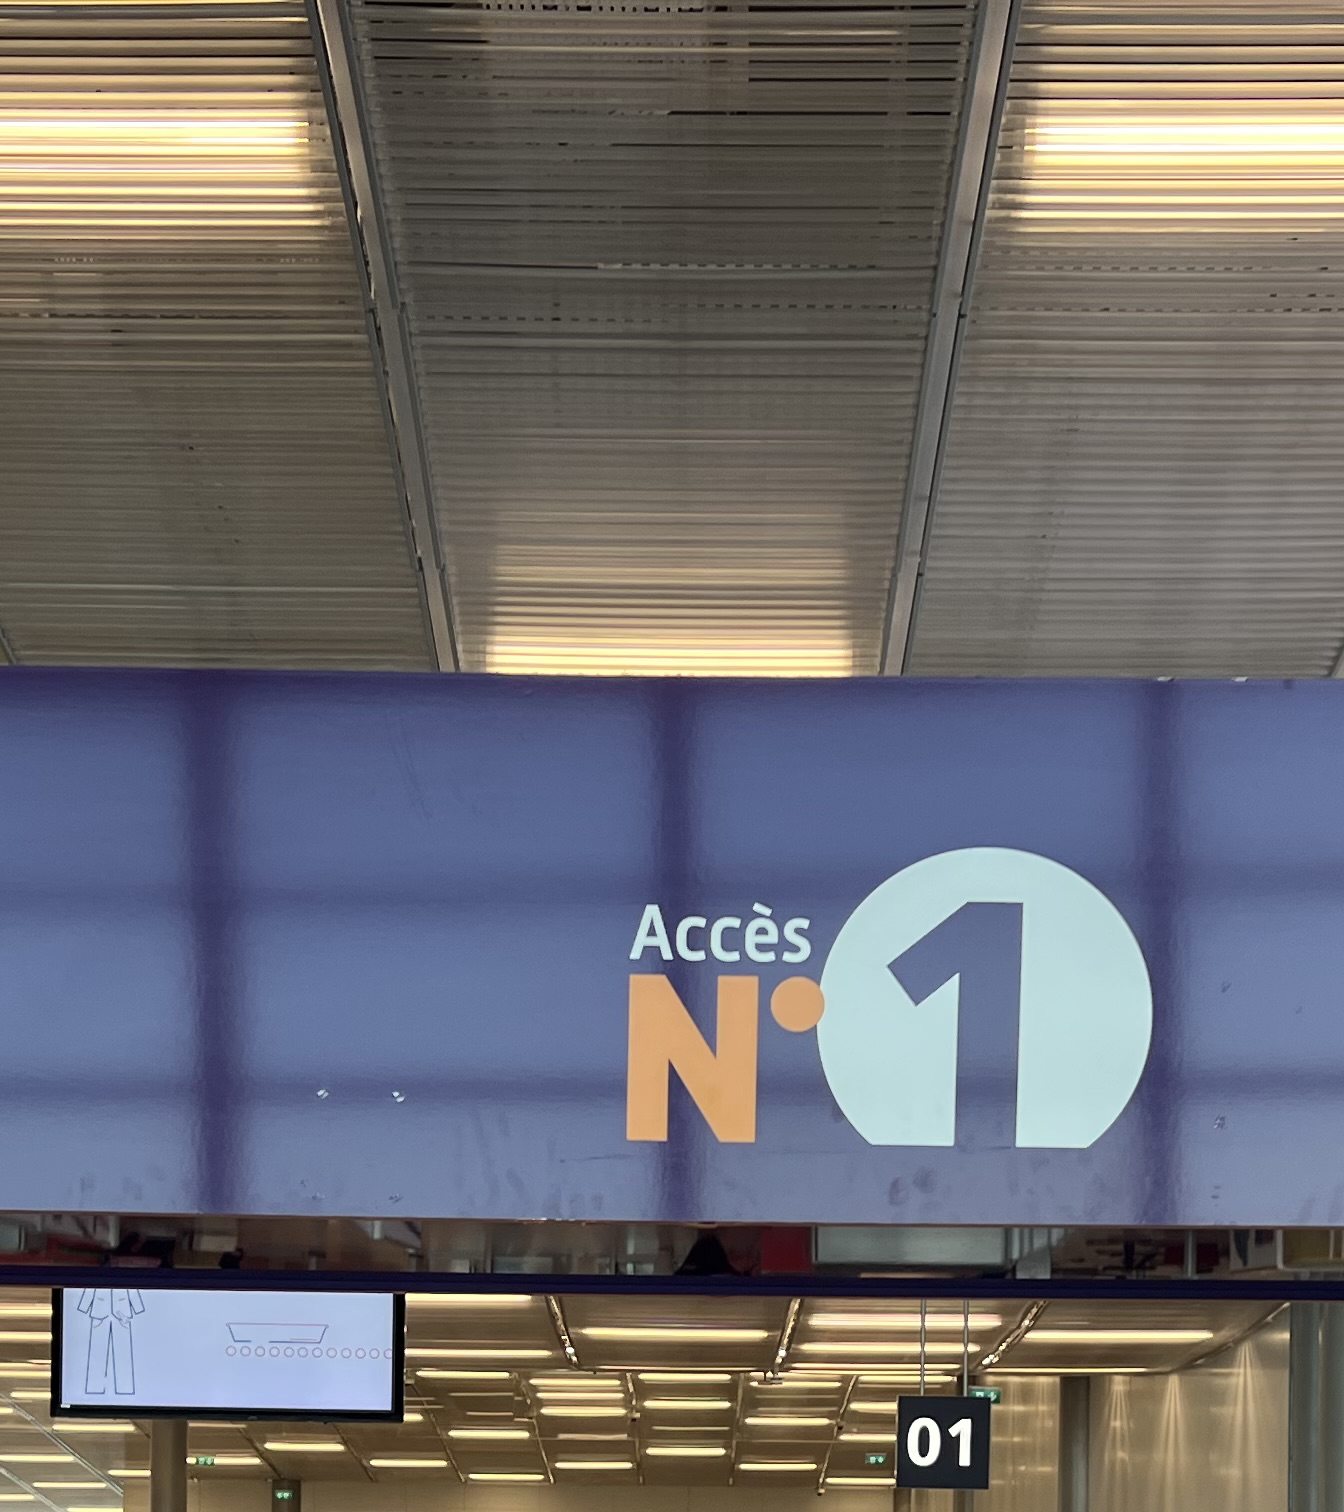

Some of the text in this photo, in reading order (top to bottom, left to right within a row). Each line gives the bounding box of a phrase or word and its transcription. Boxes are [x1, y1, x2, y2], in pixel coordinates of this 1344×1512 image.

[629, 902, 812, 963] Accès
[887, 901, 1024, 1148] 1
[907, 1417, 972, 1467] 01
